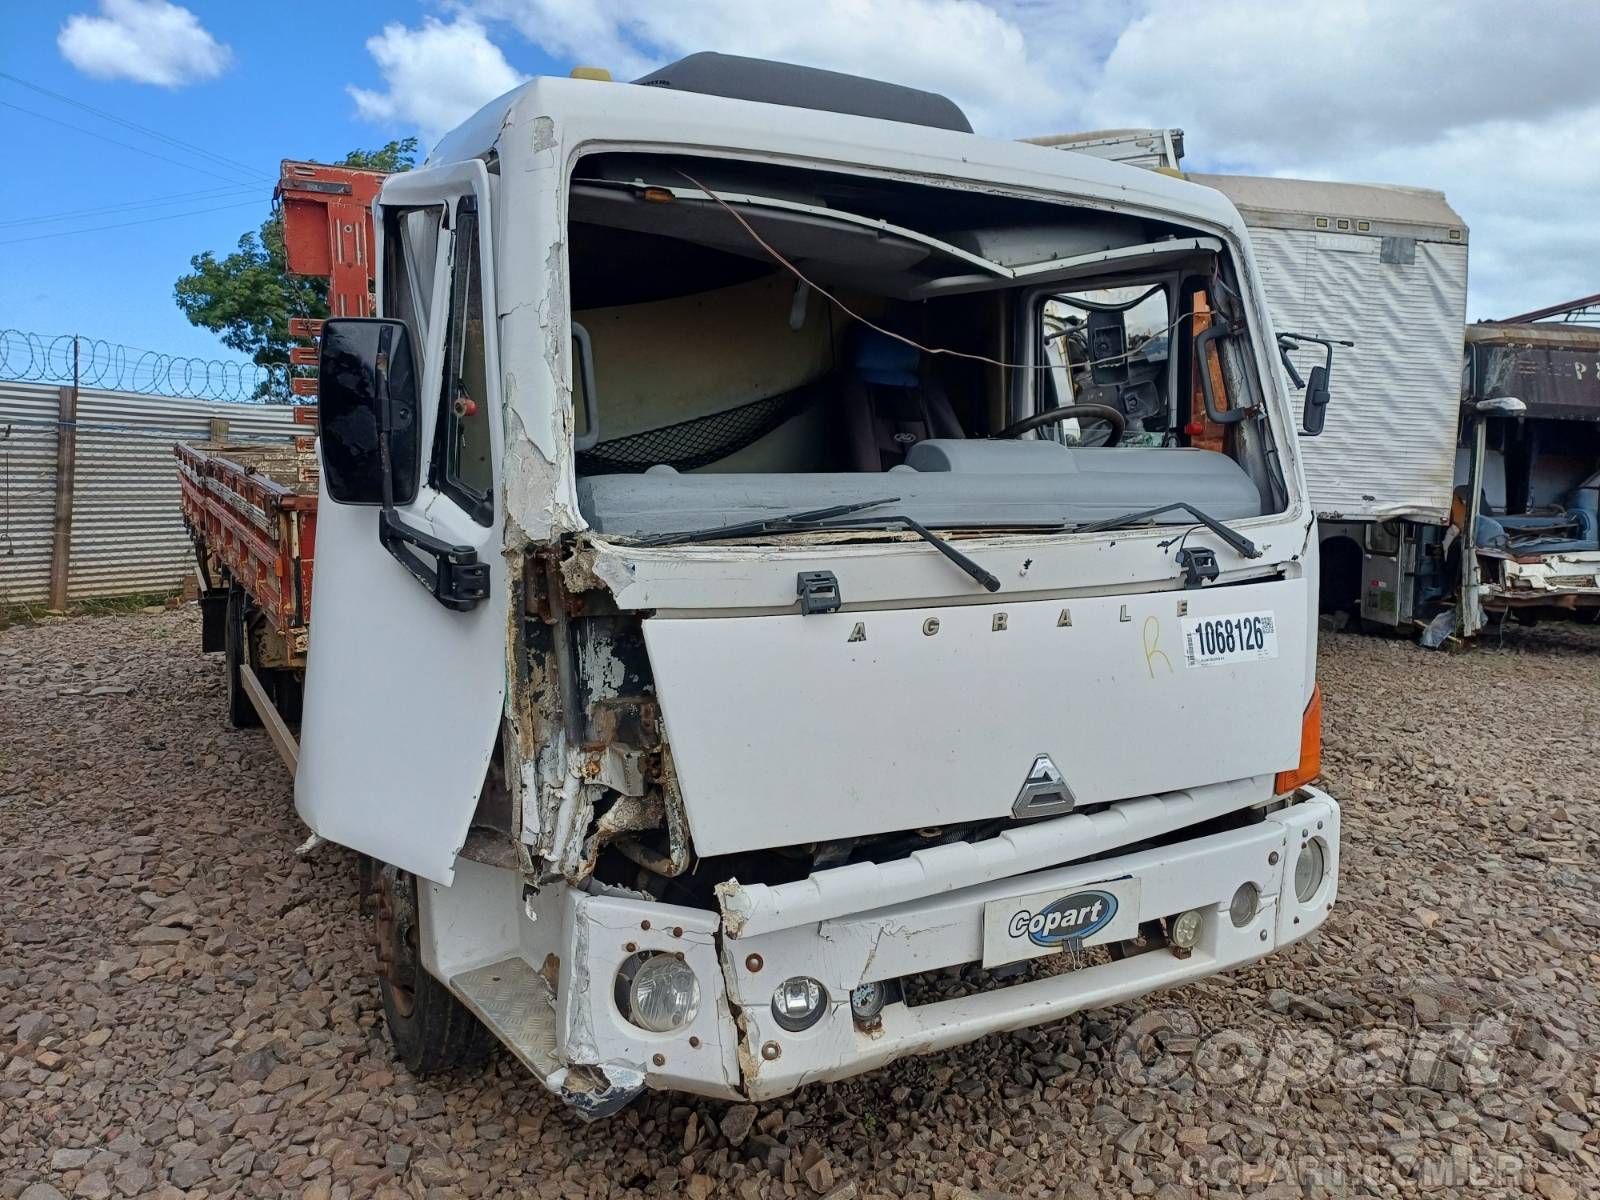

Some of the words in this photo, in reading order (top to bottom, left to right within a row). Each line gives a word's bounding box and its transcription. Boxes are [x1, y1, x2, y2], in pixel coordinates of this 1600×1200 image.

[848, 600, 1188, 642] AGRALE
[1195, 616, 1264, 655] 1068126
[1008, 899, 1103, 938] Copart
